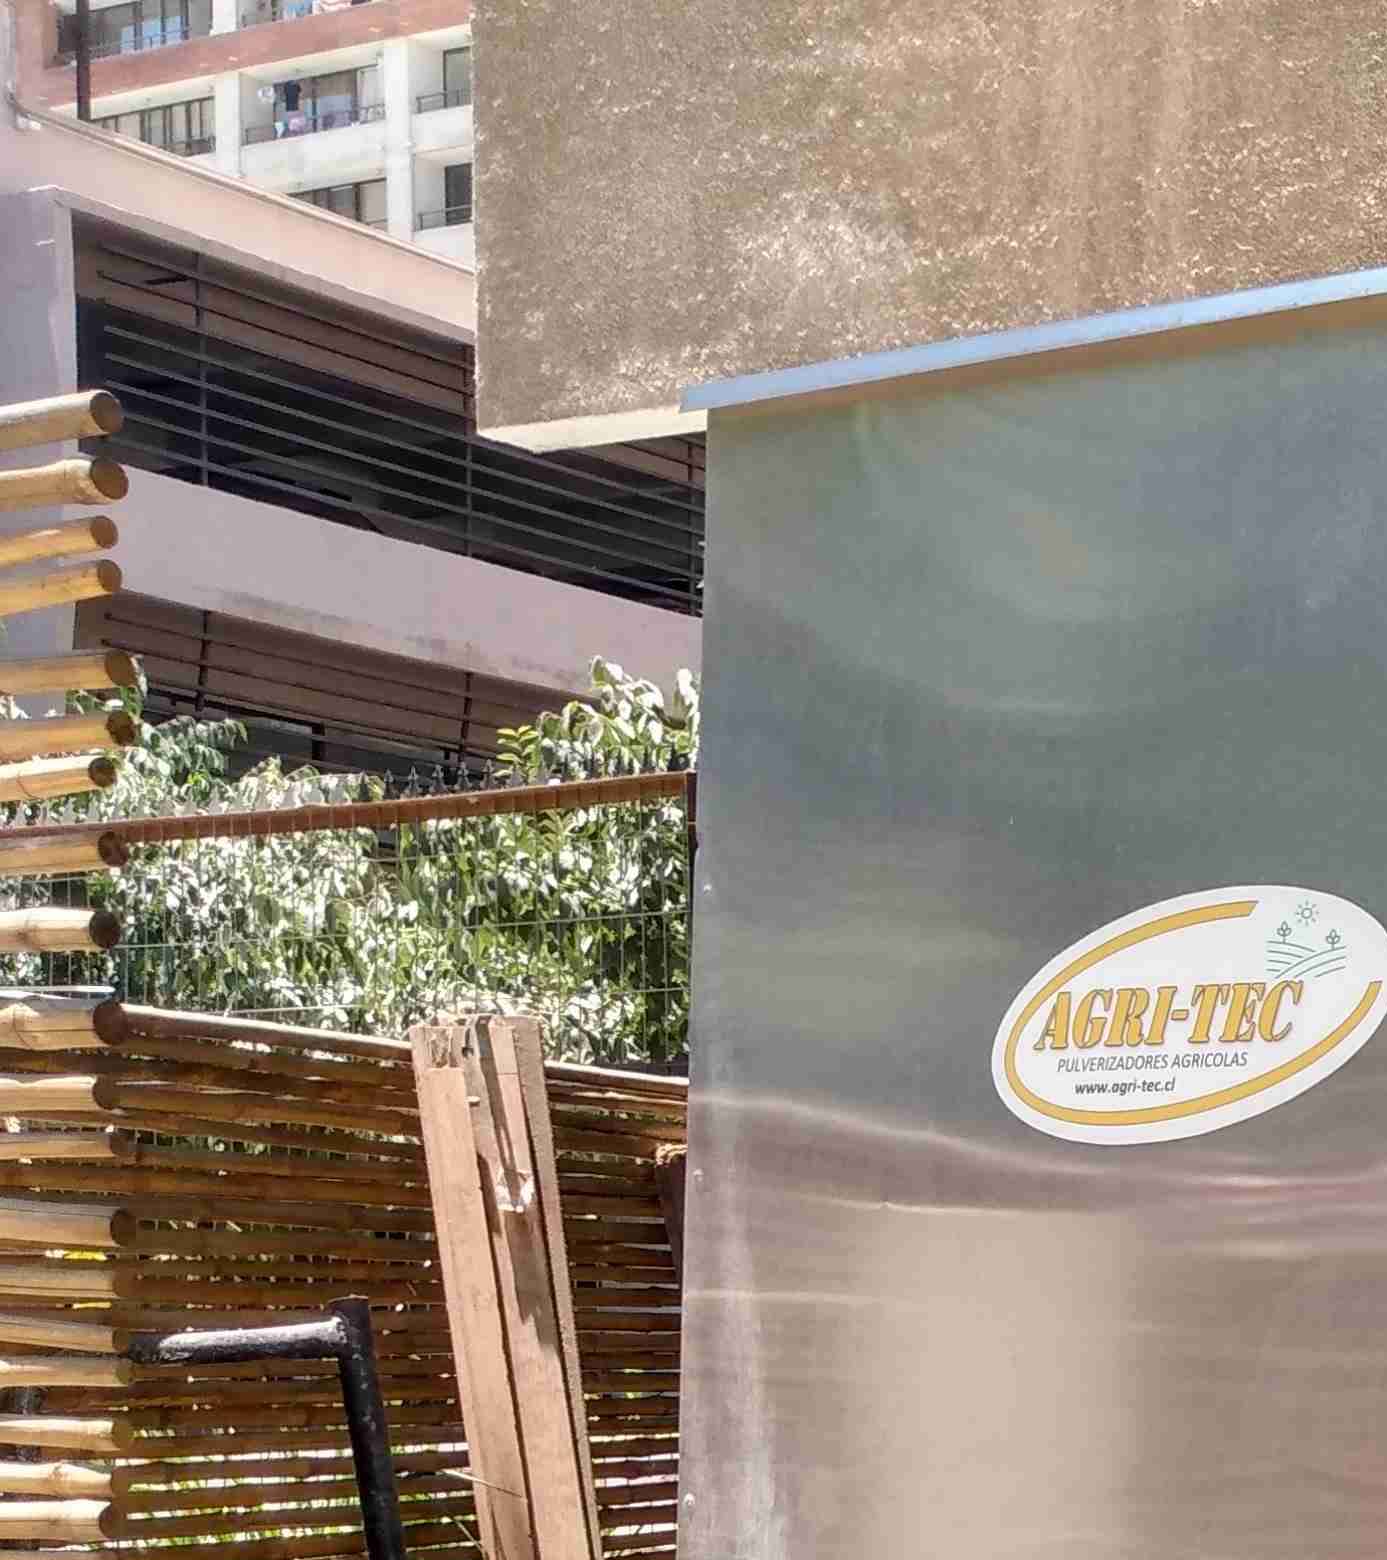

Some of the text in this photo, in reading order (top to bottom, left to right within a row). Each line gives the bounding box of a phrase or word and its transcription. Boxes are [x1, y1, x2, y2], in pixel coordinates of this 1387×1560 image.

[1033, 980, 1304, 1051] AGRI-TEC
[1057, 1051, 1248, 1072] PULVERIZADORES AGRICOLAS
[1075, 1077, 1176, 1096] www.agri-tec.cl
